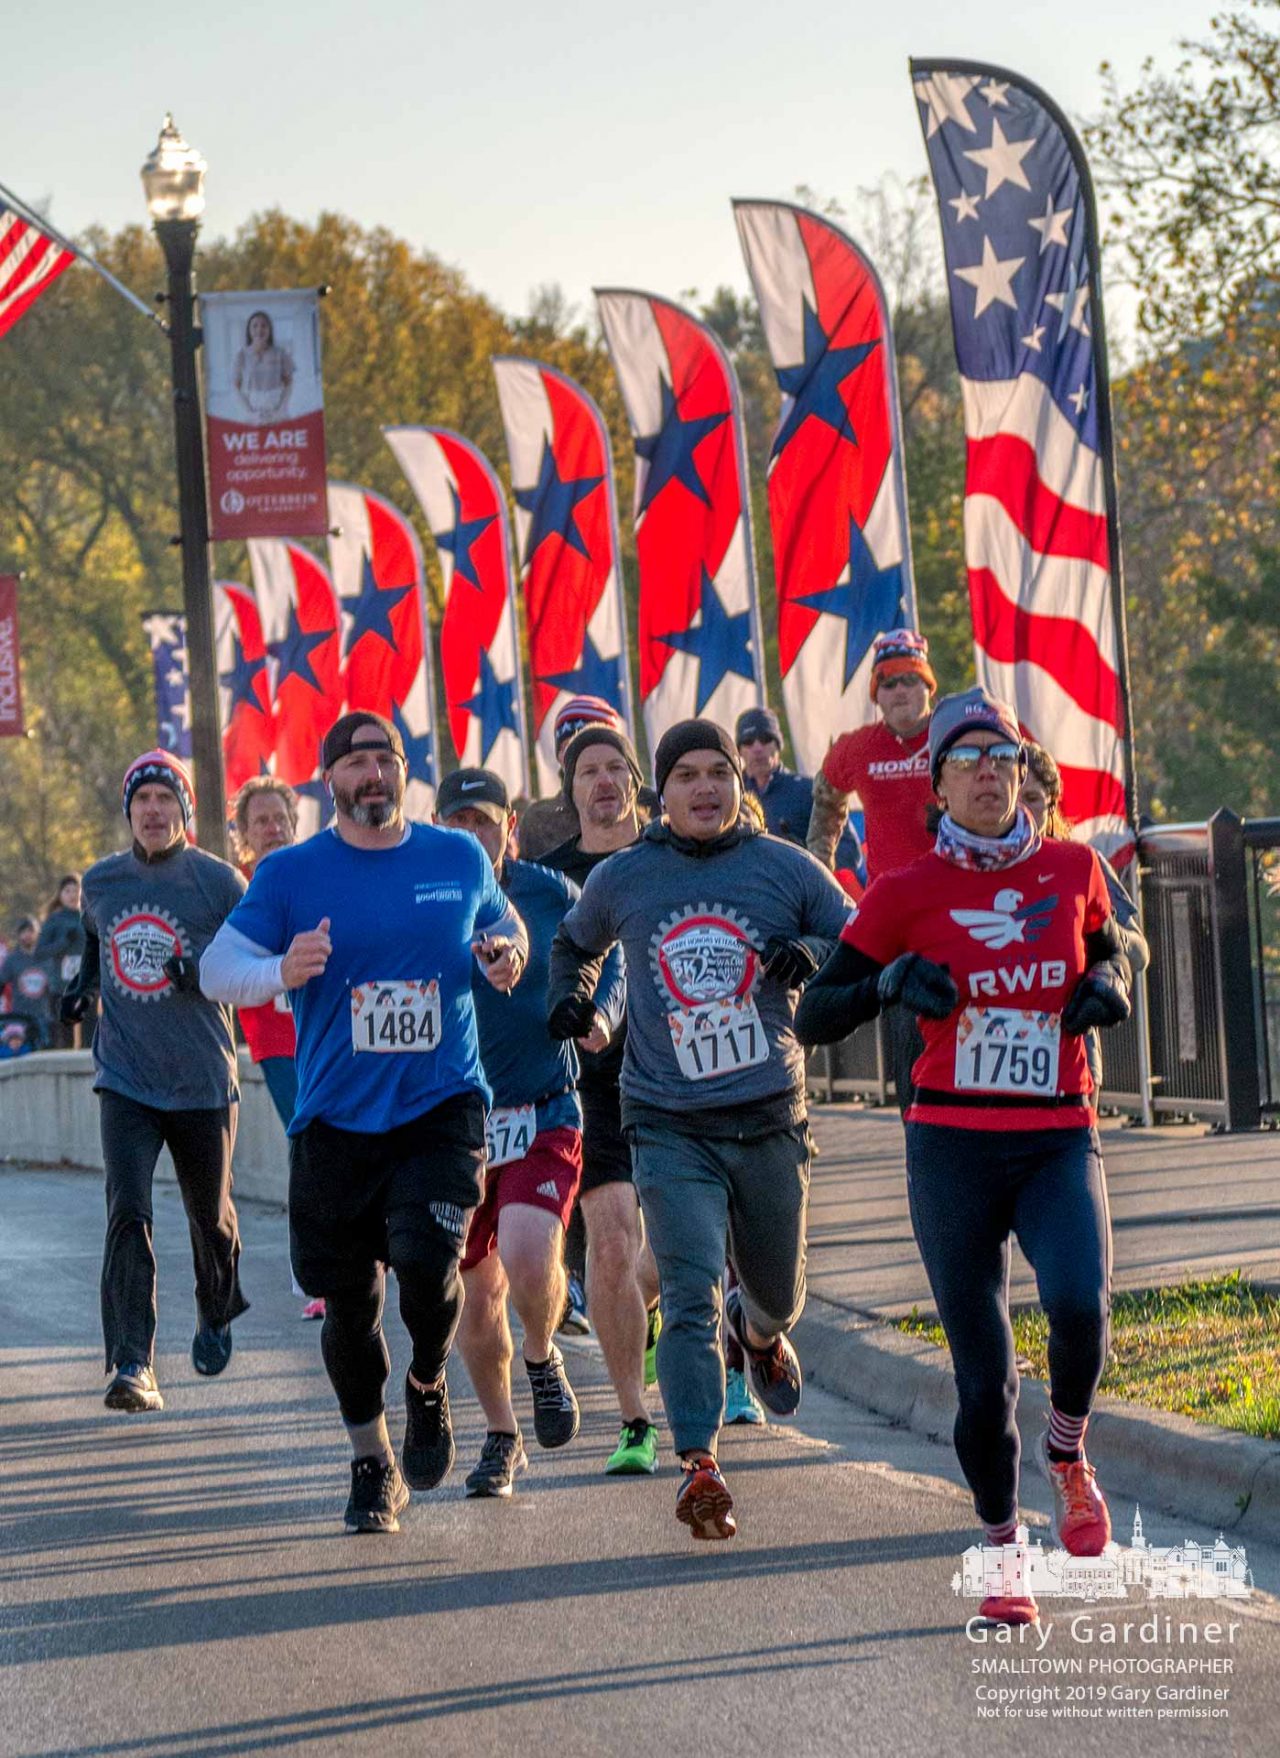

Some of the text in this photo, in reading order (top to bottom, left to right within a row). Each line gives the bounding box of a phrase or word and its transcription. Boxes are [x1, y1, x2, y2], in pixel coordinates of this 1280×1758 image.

[222, 430, 307, 451] WE ARE
[234, 453, 298, 466] delivering
[868, 758, 930, 776] HOND
[968, 960, 1067, 998] RWB
[363, 1009, 436, 1047] 1484
[686, 1022, 756, 1074] 1717
[970, 1042, 1051, 1086] 1759
